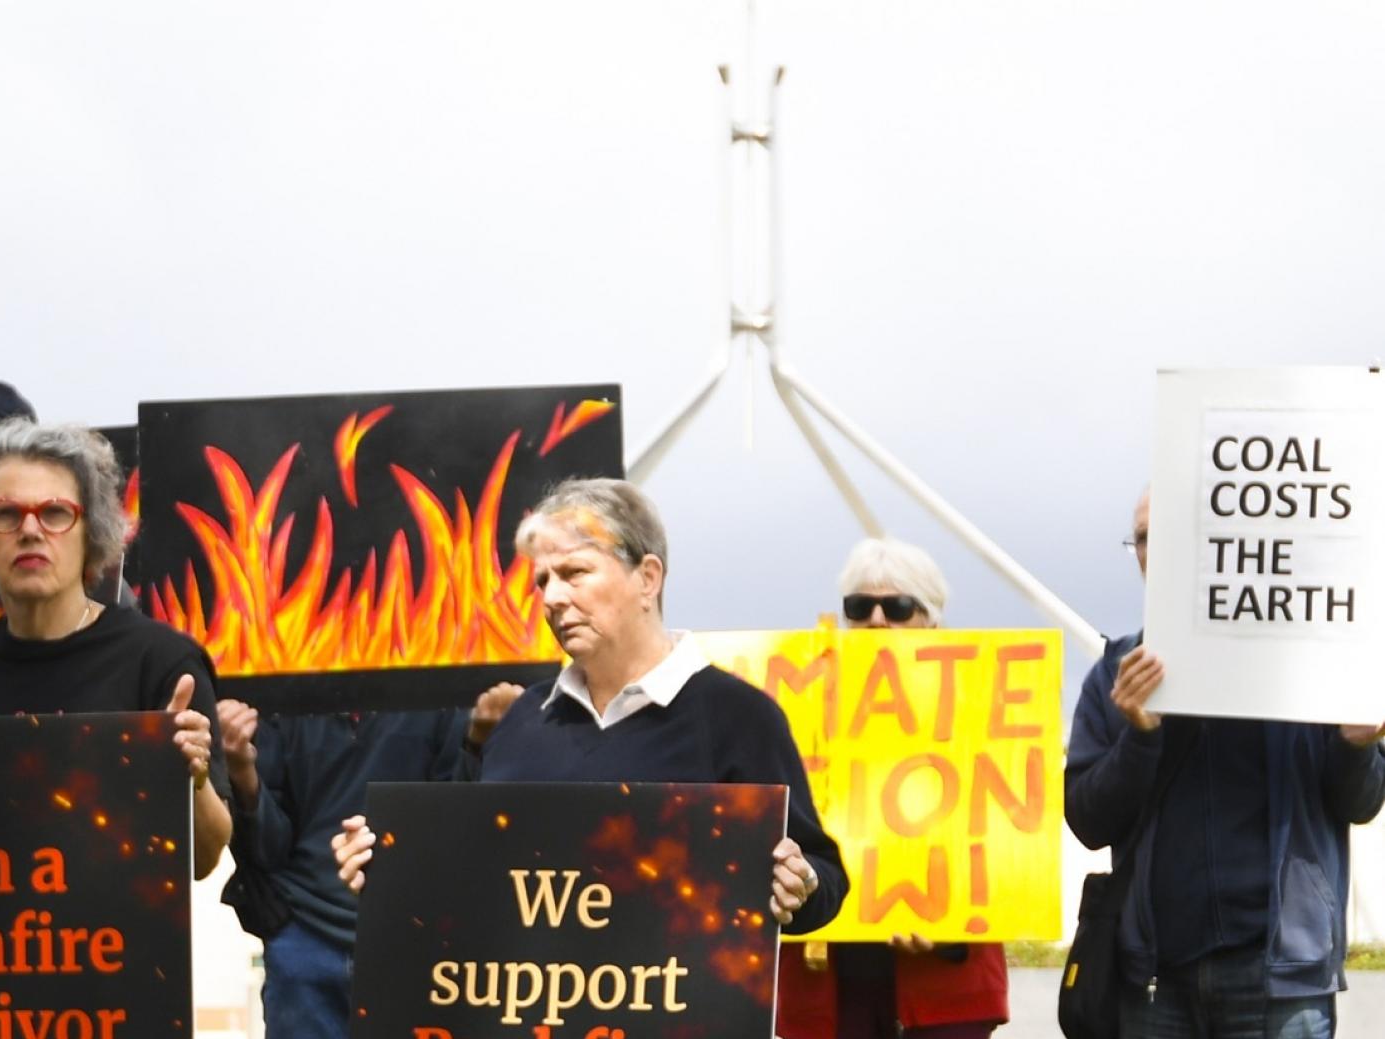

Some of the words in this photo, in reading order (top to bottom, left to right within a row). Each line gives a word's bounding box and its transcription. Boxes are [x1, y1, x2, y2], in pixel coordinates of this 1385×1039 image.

[1212, 436, 1332, 472] COAL
[1210, 481, 1352, 519] COSTS
[1209, 538, 1293, 575] THE
[1208, 585, 1354, 622] EARTH
[734, 644, 1046, 742] MATE
[30, 846, 68, 894] a
[511, 869, 613, 928] We
[429, 955, 688, 1025] support
